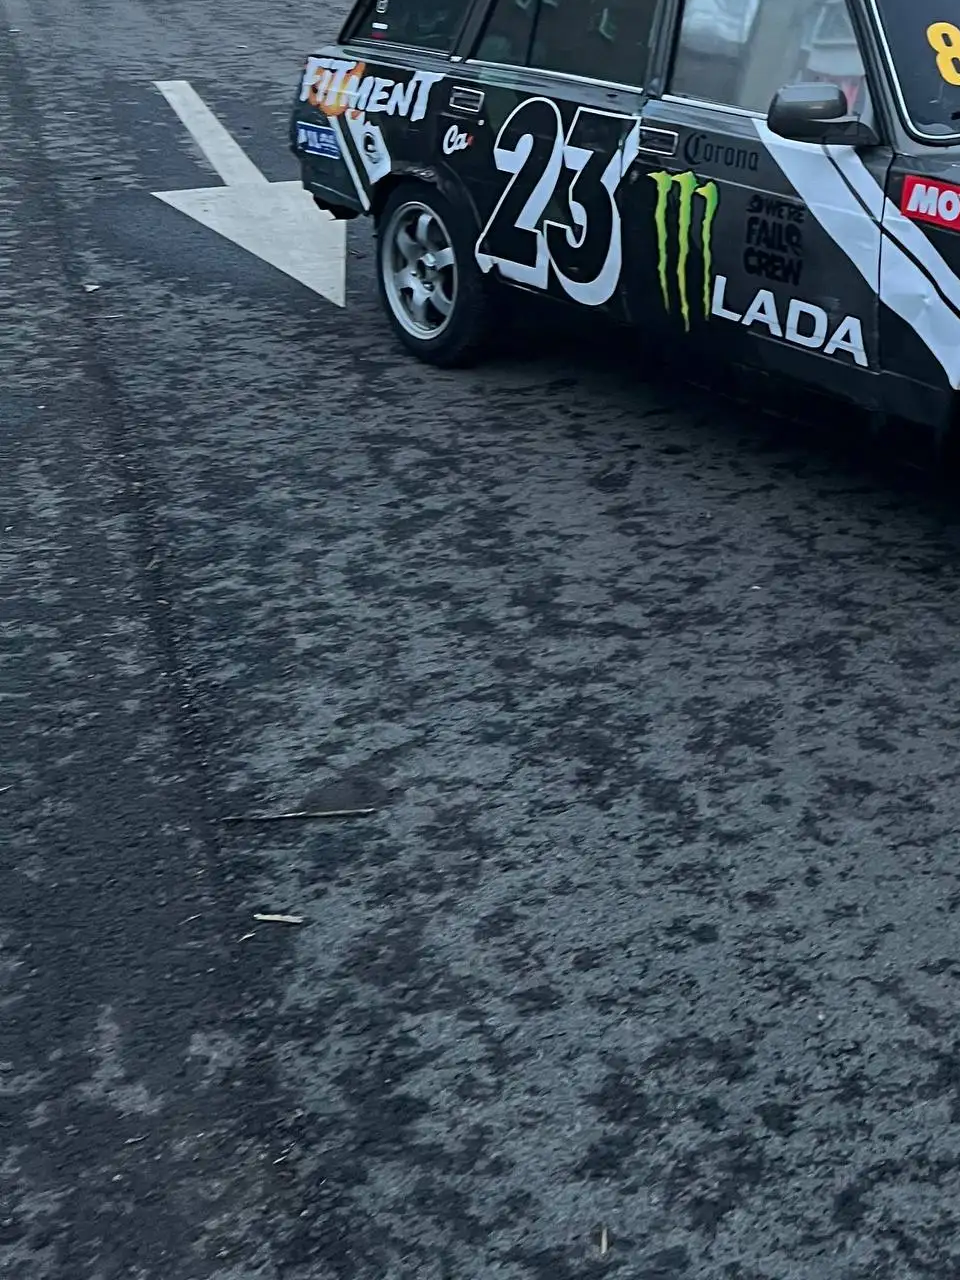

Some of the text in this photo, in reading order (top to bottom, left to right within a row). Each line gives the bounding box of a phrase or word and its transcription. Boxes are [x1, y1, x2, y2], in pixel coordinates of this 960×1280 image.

[300, 56, 446, 122] FITMENT
[684, 131, 759, 172] Corona
[475, 96, 642, 306] 23
[712, 275, 868, 368] LADA
